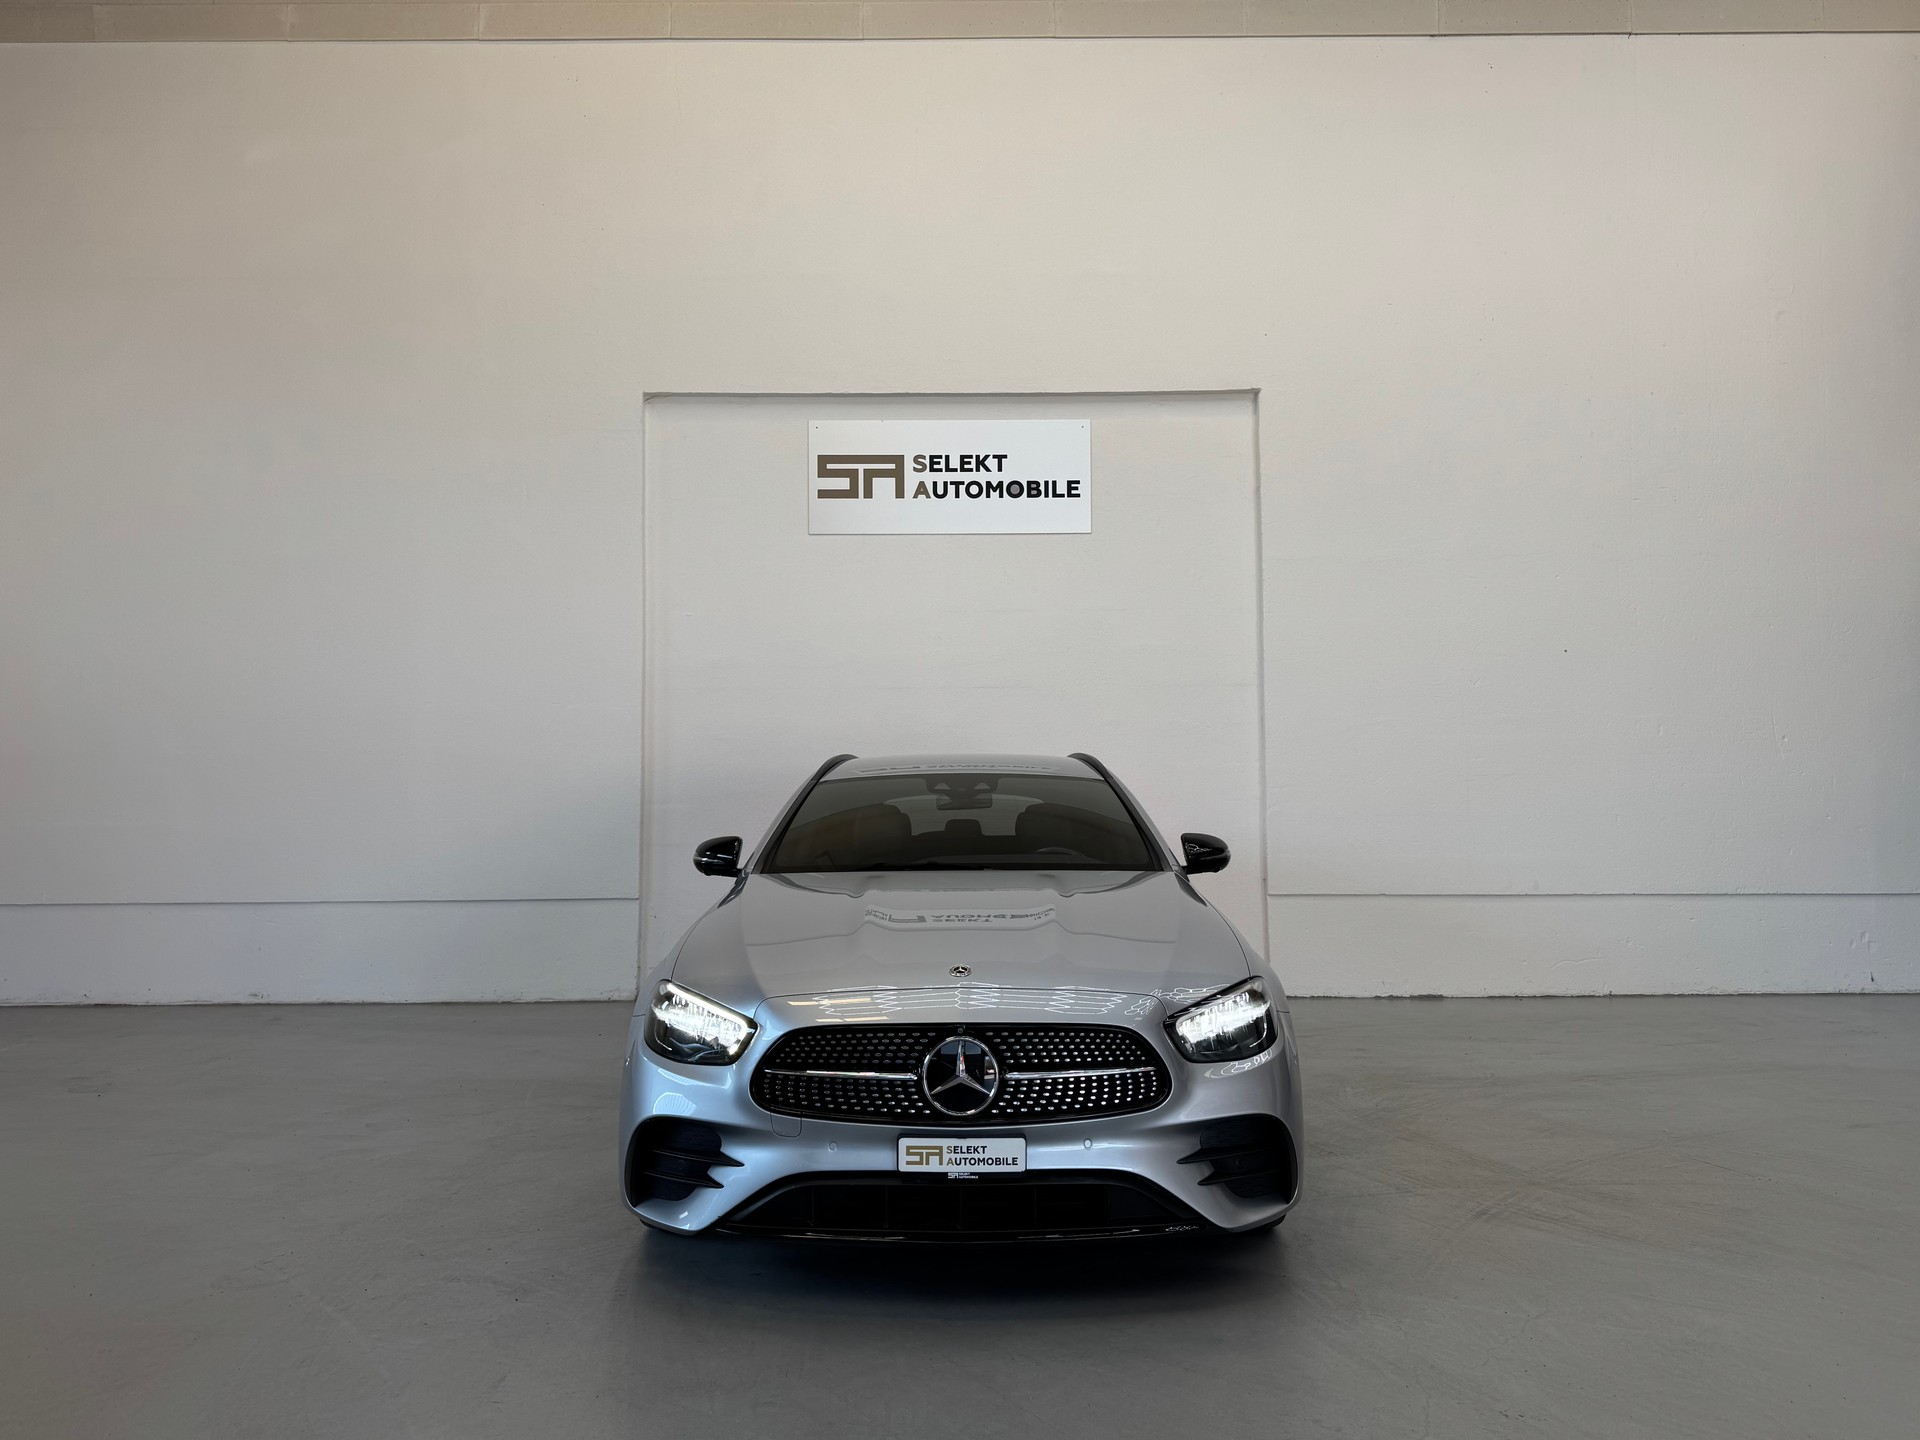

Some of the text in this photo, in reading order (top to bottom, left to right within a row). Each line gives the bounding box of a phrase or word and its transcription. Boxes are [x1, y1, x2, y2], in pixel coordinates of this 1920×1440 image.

[912, 454, 1008, 473] SELEKT
[912, 480, 1081, 499] AUTOMOBILE
[946, 1145, 988, 1155] SELEKT
[946, 1157, 1019, 1166] AUTOMOBILE
